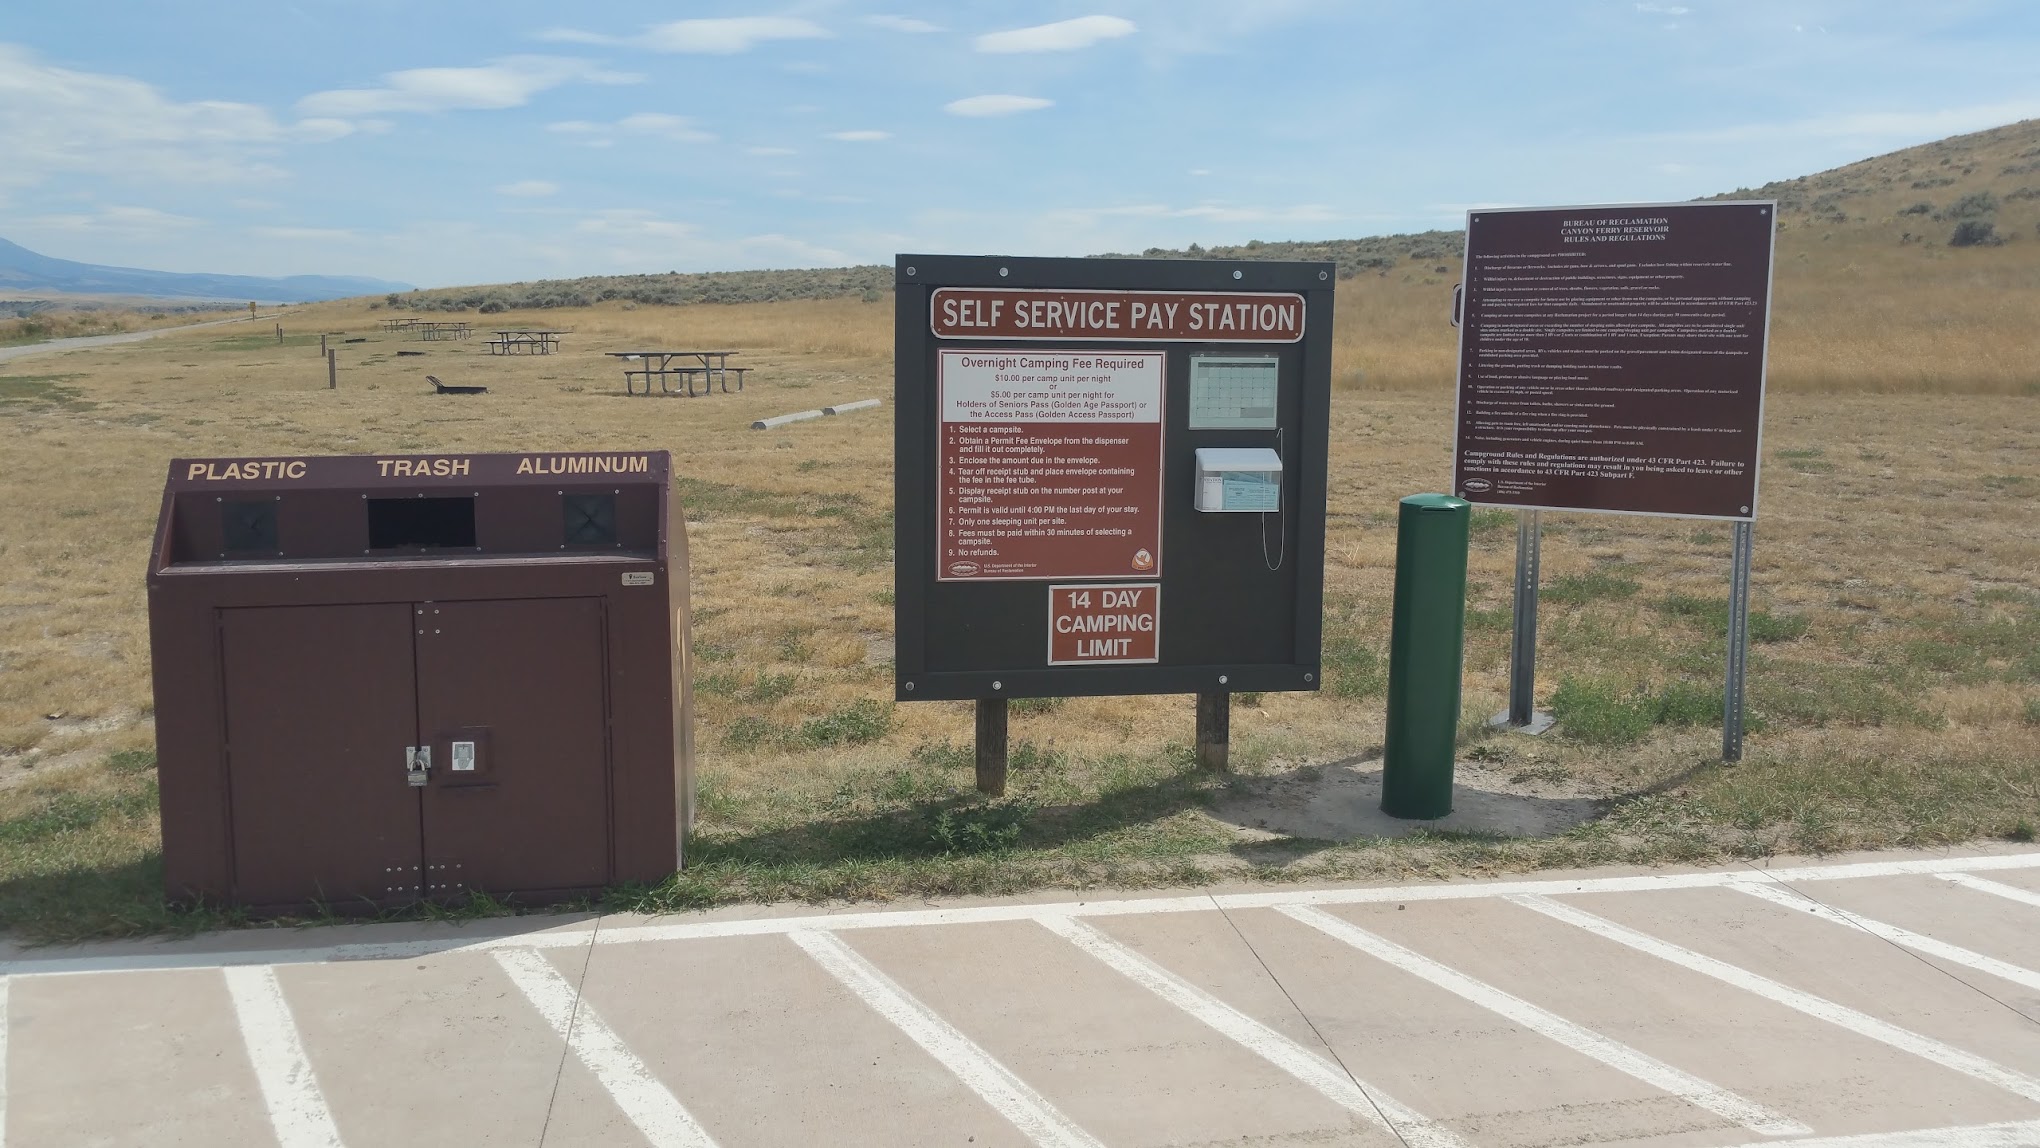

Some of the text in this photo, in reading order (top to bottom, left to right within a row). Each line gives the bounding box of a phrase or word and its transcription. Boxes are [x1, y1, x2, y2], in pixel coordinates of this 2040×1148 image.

[944, 299, 1294, 331] SELF SERVICE PAY STATION
[962, 357, 1144, 371] Overnight Camping Fee Required
[1092, 375, 1111, 383] night
[1083, 392, 1102, 400] night
[1051, 401, 1081, 409] (Golden
[1084, 402, 1098, 410] Age
[1036, 411, 1065, 419] (Golden
[1099, 411, 1134, 419] Passport)
[989, 426, 1023, 434] campsite.
[1030, 437, 1062, 445] Envelope
[1095, 437, 1129, 445] dispenser
[1005, 446, 1045, 454] completely.
[516, 456, 649, 475] ALUMINUM
[1067, 457, 1100, 465] envelope.
[187, 460, 307, 481] PLASTIC
[376, 459, 470, 477] TRASH
[987, 468, 1011, 476] receipt
[1045, 468, 1064, 476] place
[1066, 468, 1097, 476] envelope
[1099, 468, 1134, 476] containing
[959, 487, 985, 496] Display
[987, 487, 1011, 496] receipt
[1083, 487, 1098, 495] post
[959, 495, 993, 504] campsite.
[1084, 506, 1096, 514] day
[1124, 506, 1139, 514] stay.
[959, 518, 975, 526] Only
[992, 518, 1021, 526] sleeping
[1007, 529, 1022, 537] paid
[1095, 528, 1126, 537] selecting
[959, 538, 992, 546] campsite.
[1068, 590, 1142, 609] 14 DAY
[1056, 613, 1153, 634] CAMPING
[1077, 638, 1132, 657] LIMIT
